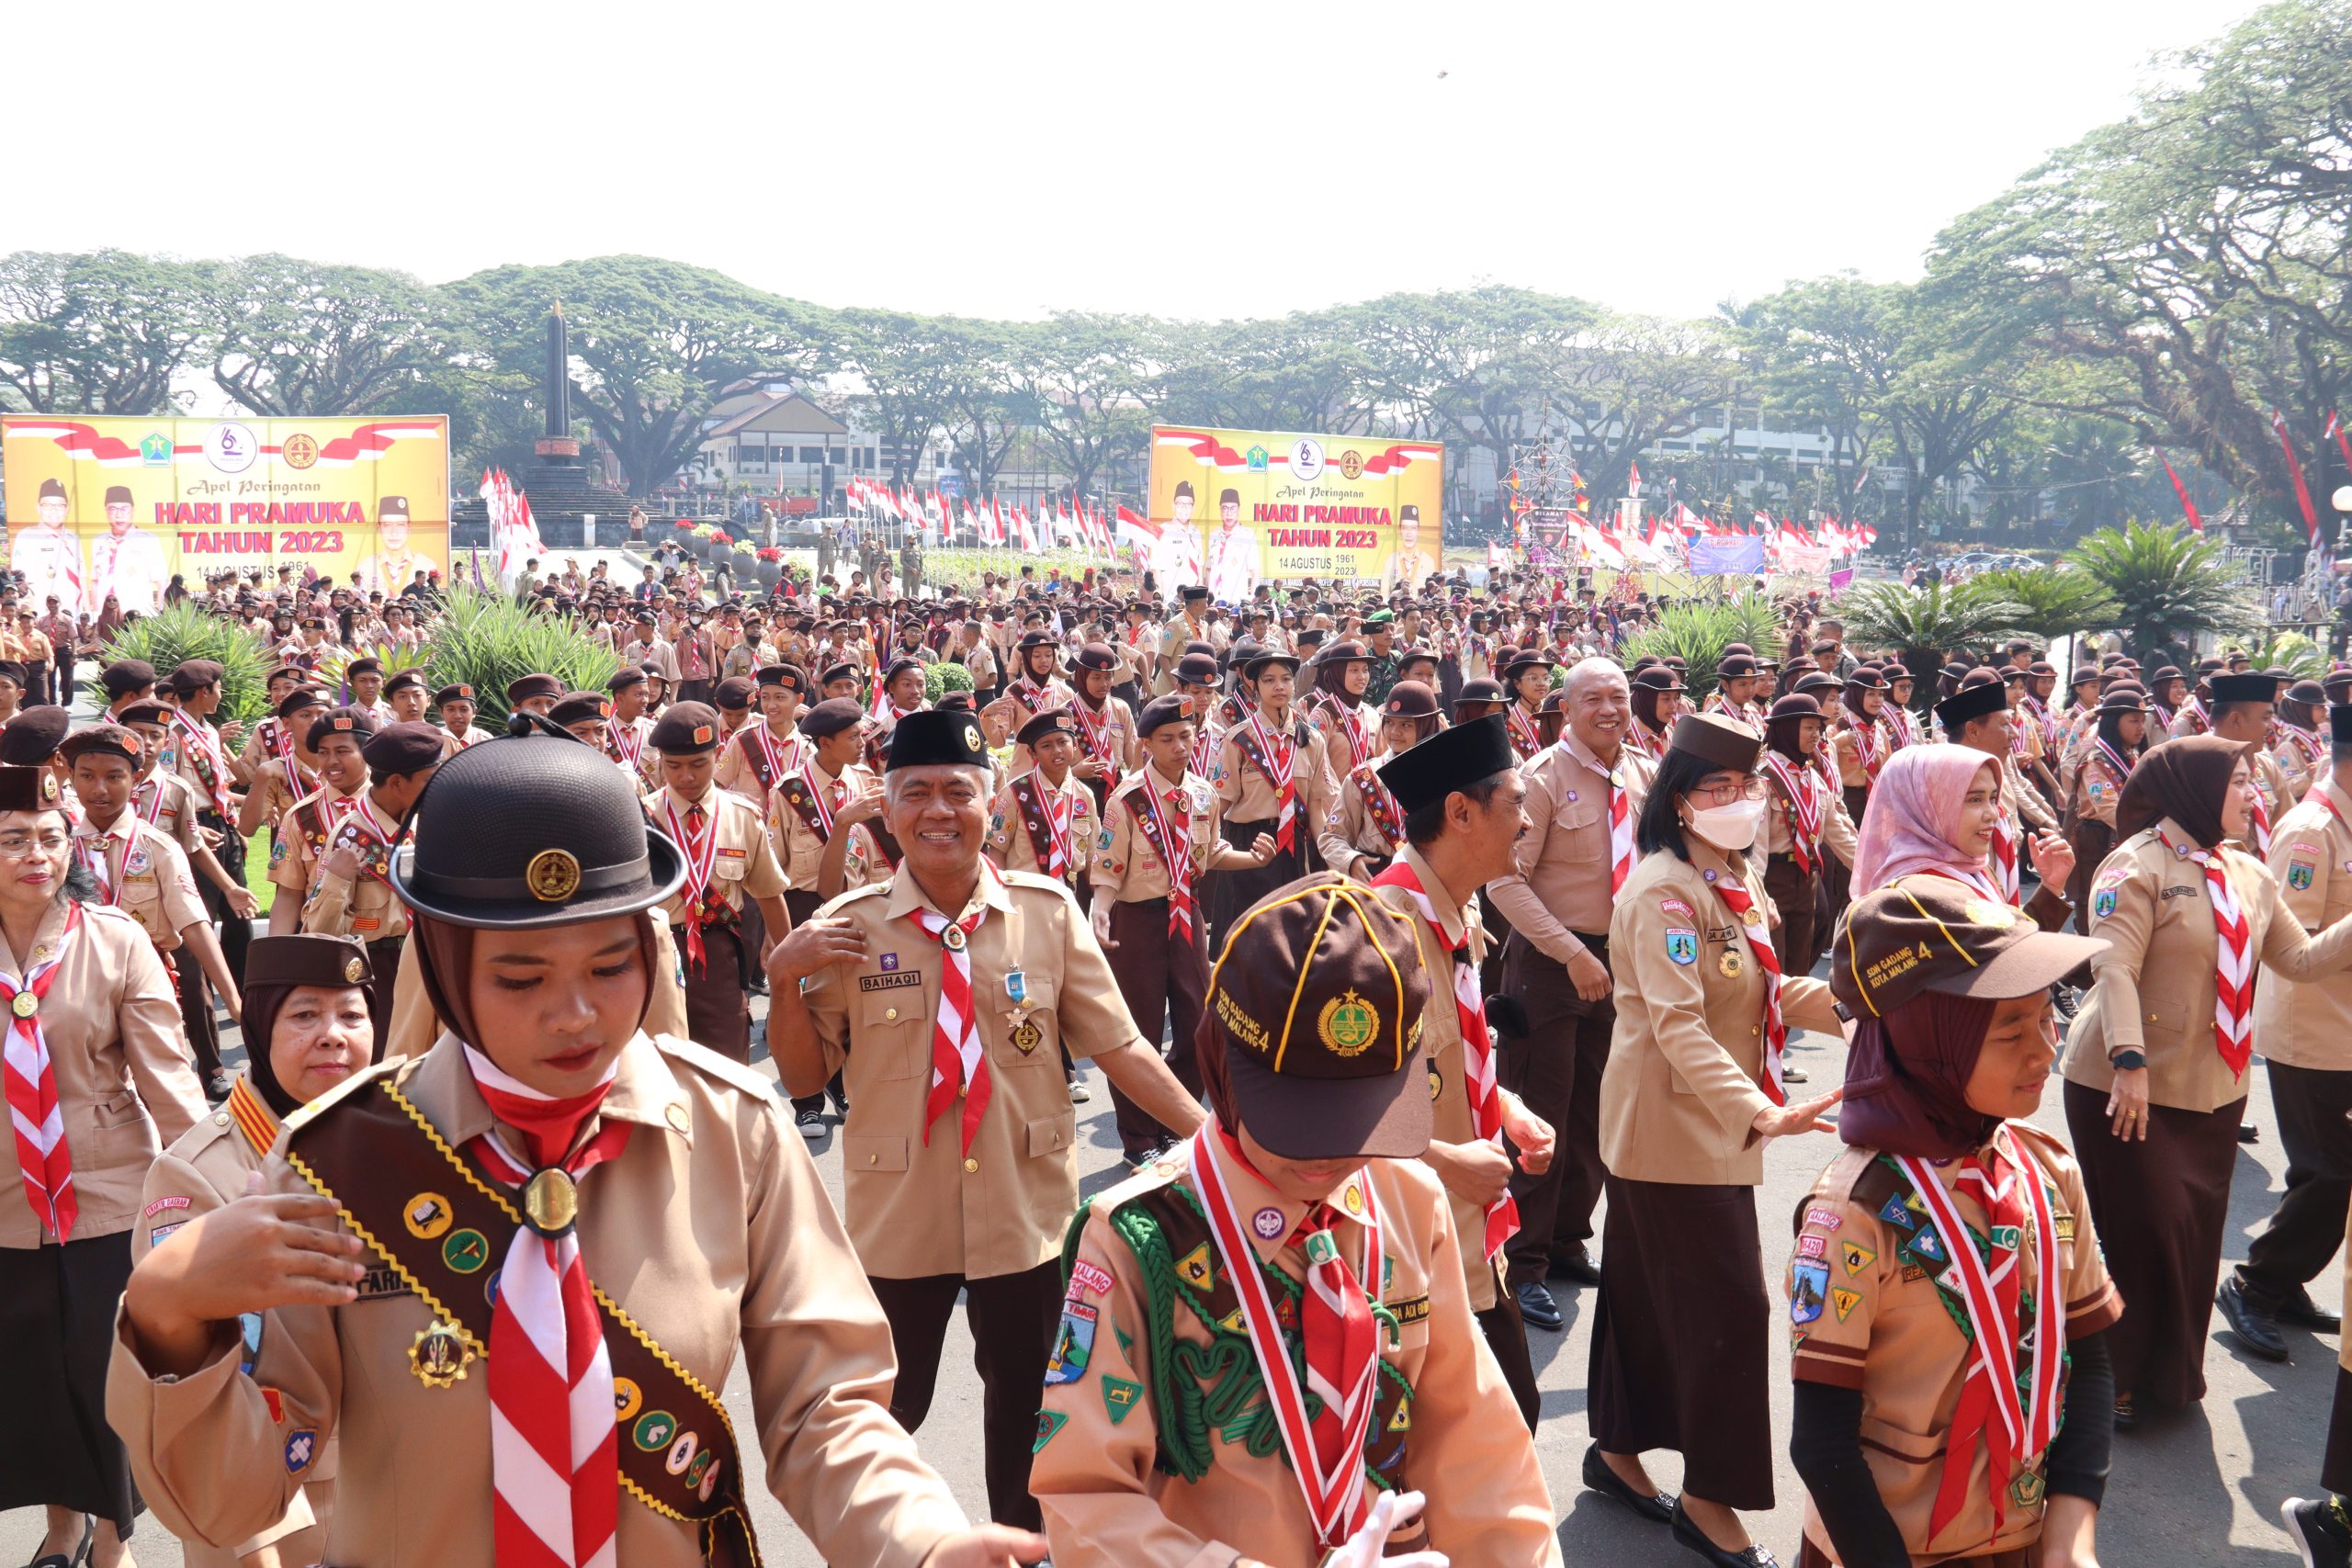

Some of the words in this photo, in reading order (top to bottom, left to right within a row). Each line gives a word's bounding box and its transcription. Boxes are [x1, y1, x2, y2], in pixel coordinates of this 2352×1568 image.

[187, 480, 231, 495] Apel
[238, 479, 321, 496] Peringatan
[1276, 486, 1306, 499] Apel
[1309, 487, 1364, 500] Peringatan
[154, 502, 222, 524] HARI
[230, 502, 366, 524] PRAMUKA
[1253, 503, 1299, 523] HARI
[1304, 505, 1393, 525] PRAMUKA
[177, 531, 273, 554] TAHUN
[279, 531, 345, 554] 2023
[1267, 528, 1330, 548] TAHUN
[1335, 530, 1378, 549] 2023
[1279, 558, 1288, 569] 14
[1290, 558, 1332, 570] AGUSTUS
[1336, 554, 1355, 563] 1961
[1918, 940, 1933, 959] 4
[1866, 963, 1882, 978] SDN
[1880, 946, 1913, 970] GADANG
[1869, 972, 1890, 989] KOTA
[1887, 956, 1918, 979] MALANG
[864, 974, 916, 989] BAIHAQI
[1230, 1000, 1261, 1035] GADANG
[1227, 1016, 1259, 1047] MALANG
[1258, 1031, 1270, 1053] 4
